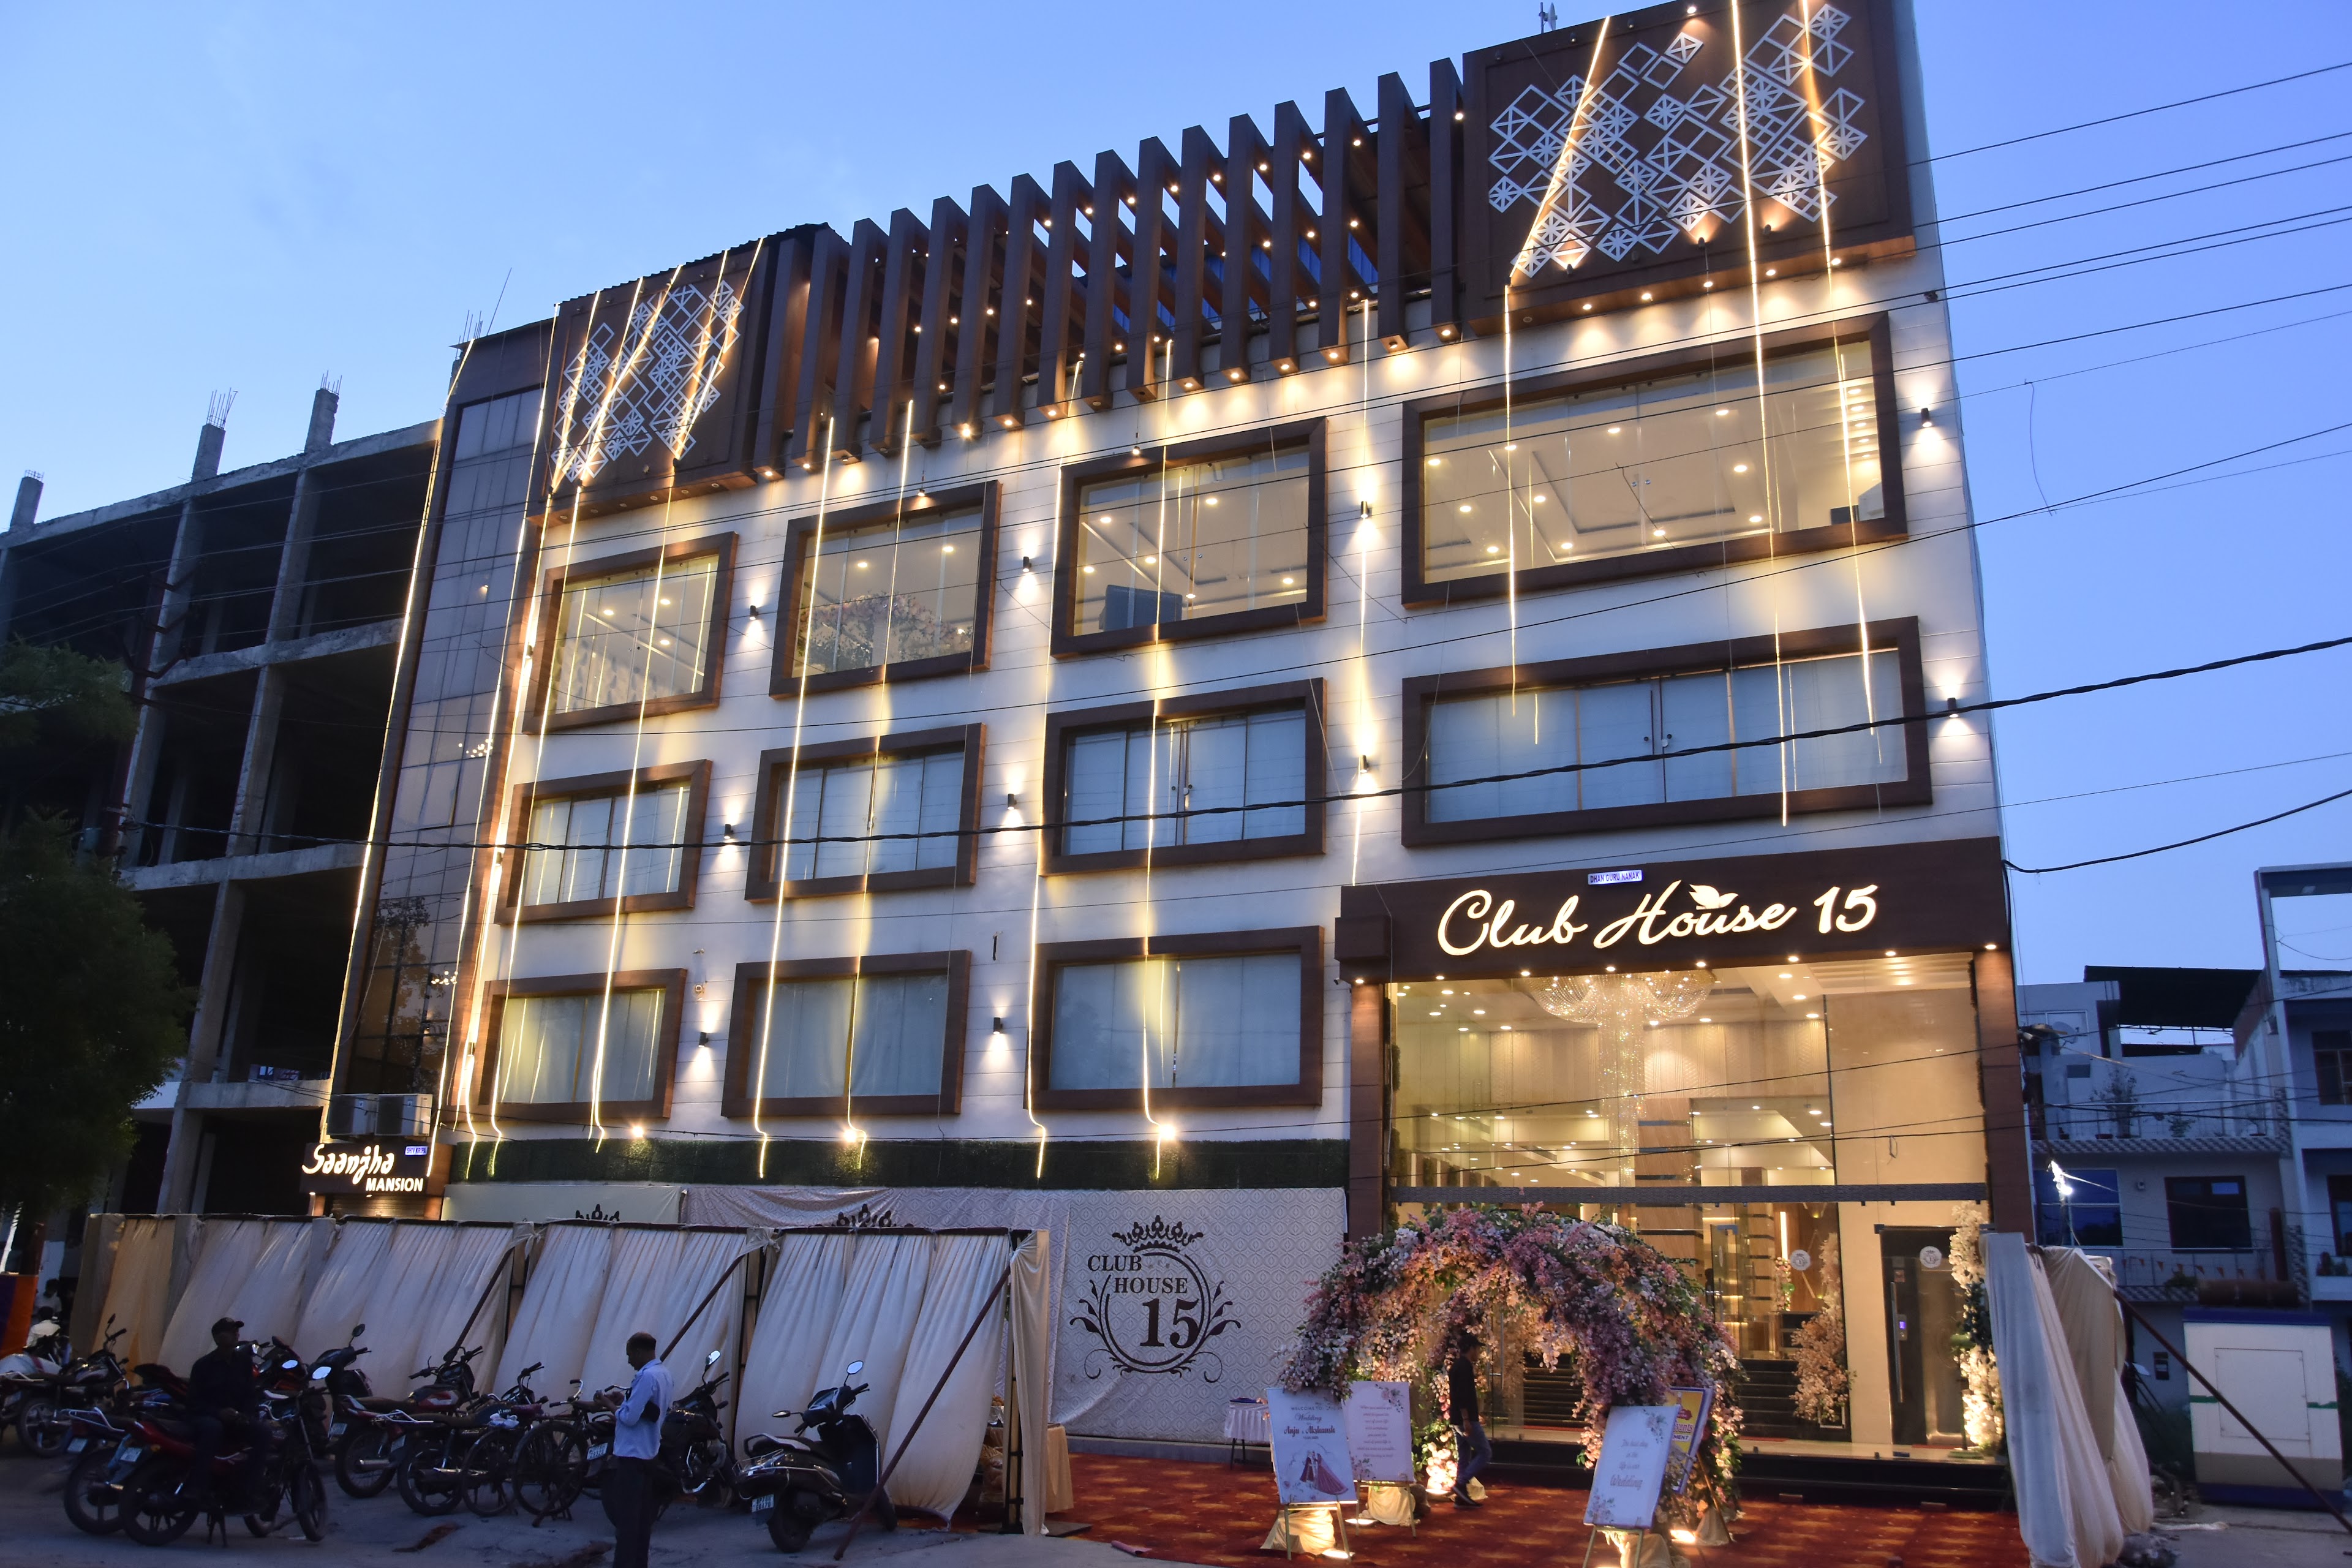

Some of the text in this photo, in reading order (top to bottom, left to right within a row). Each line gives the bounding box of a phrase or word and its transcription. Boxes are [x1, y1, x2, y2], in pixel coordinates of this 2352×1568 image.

[1590, 875, 1604, 883] DHAN
[1621, 872, 1640, 880] NANAK
[1437, 879, 1879, 956] Club House 15
[301, 1143, 395, 1185] Saanjha
[365, 1177, 424, 1192] MANSION
[1087, 1254, 1142, 1272] CLUB
[1113, 1277, 1188, 1294] HOUSE
[1139, 1297, 1199, 1349] 15
[1294, 1412, 1322, 1423] Wedding
